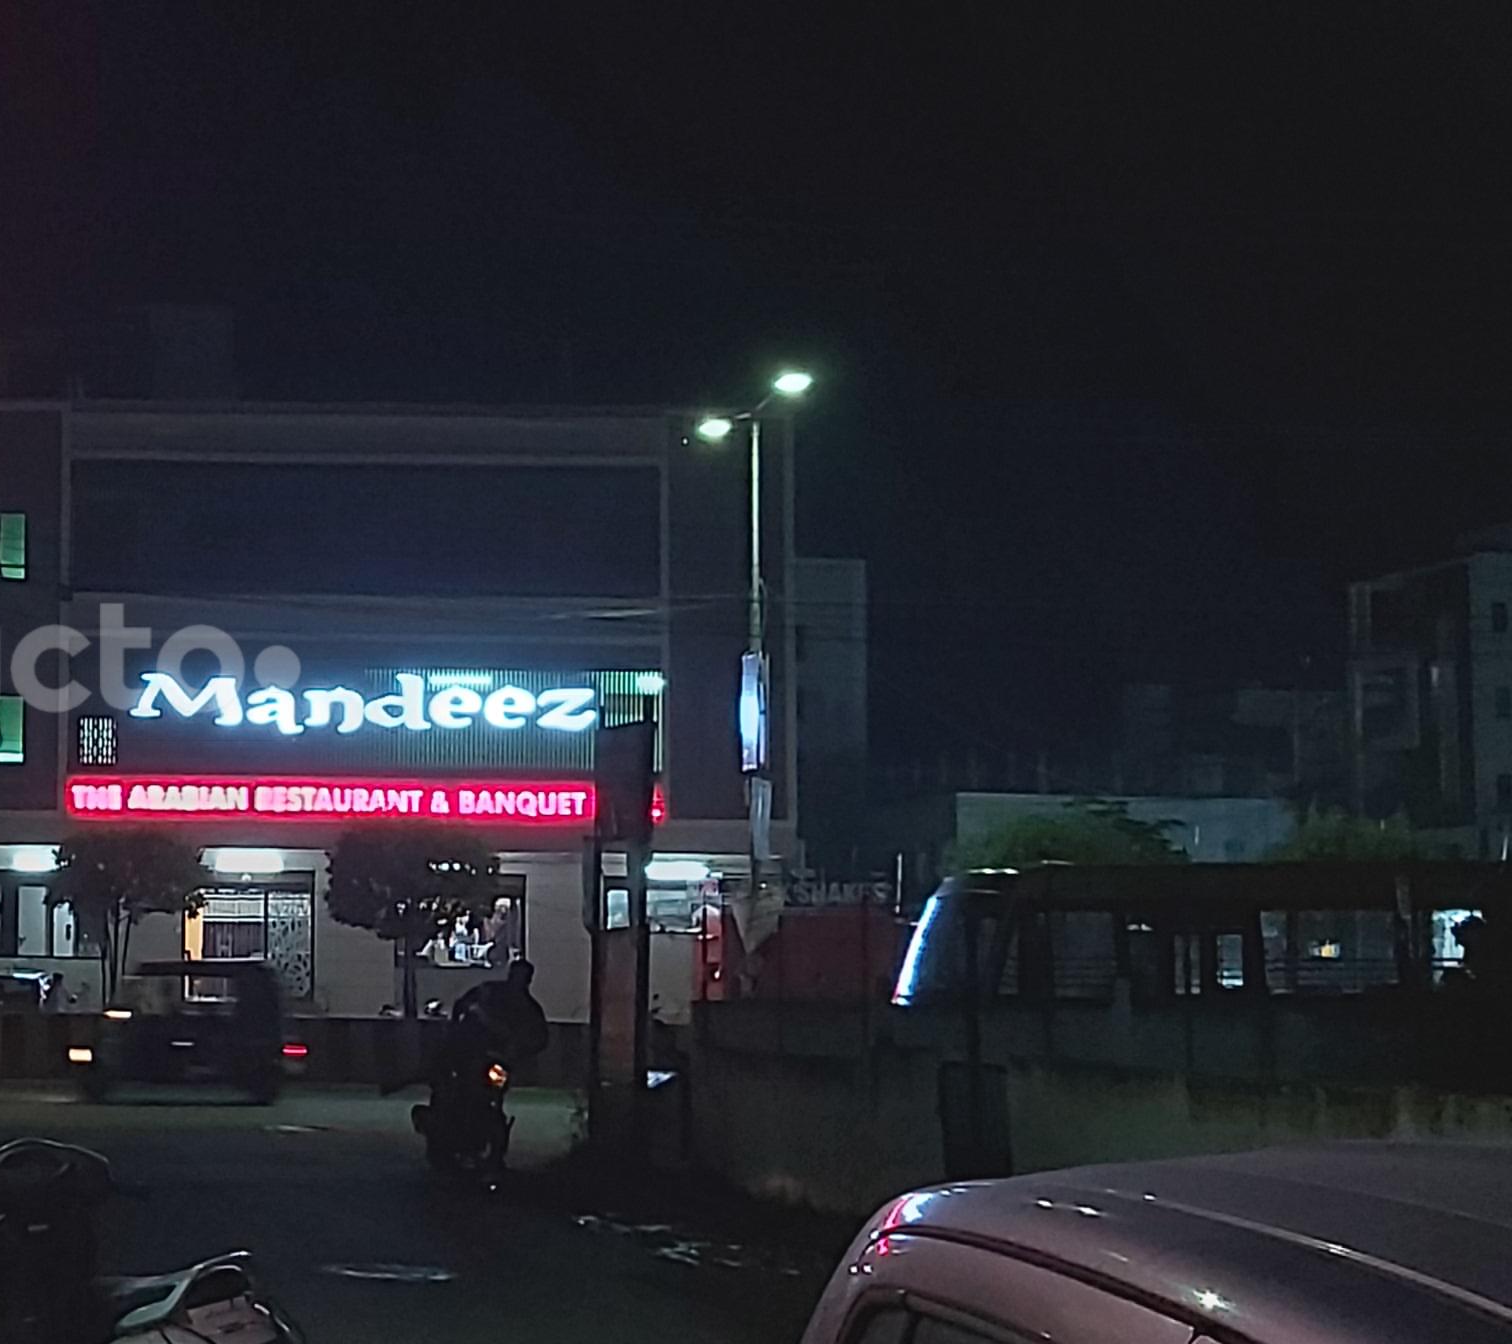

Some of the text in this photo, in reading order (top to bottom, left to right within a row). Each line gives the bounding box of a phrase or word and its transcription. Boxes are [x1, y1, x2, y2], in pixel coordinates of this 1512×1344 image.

[71, 784, 587, 817] THE ARABIAN RESTAURANT & BANQUET
